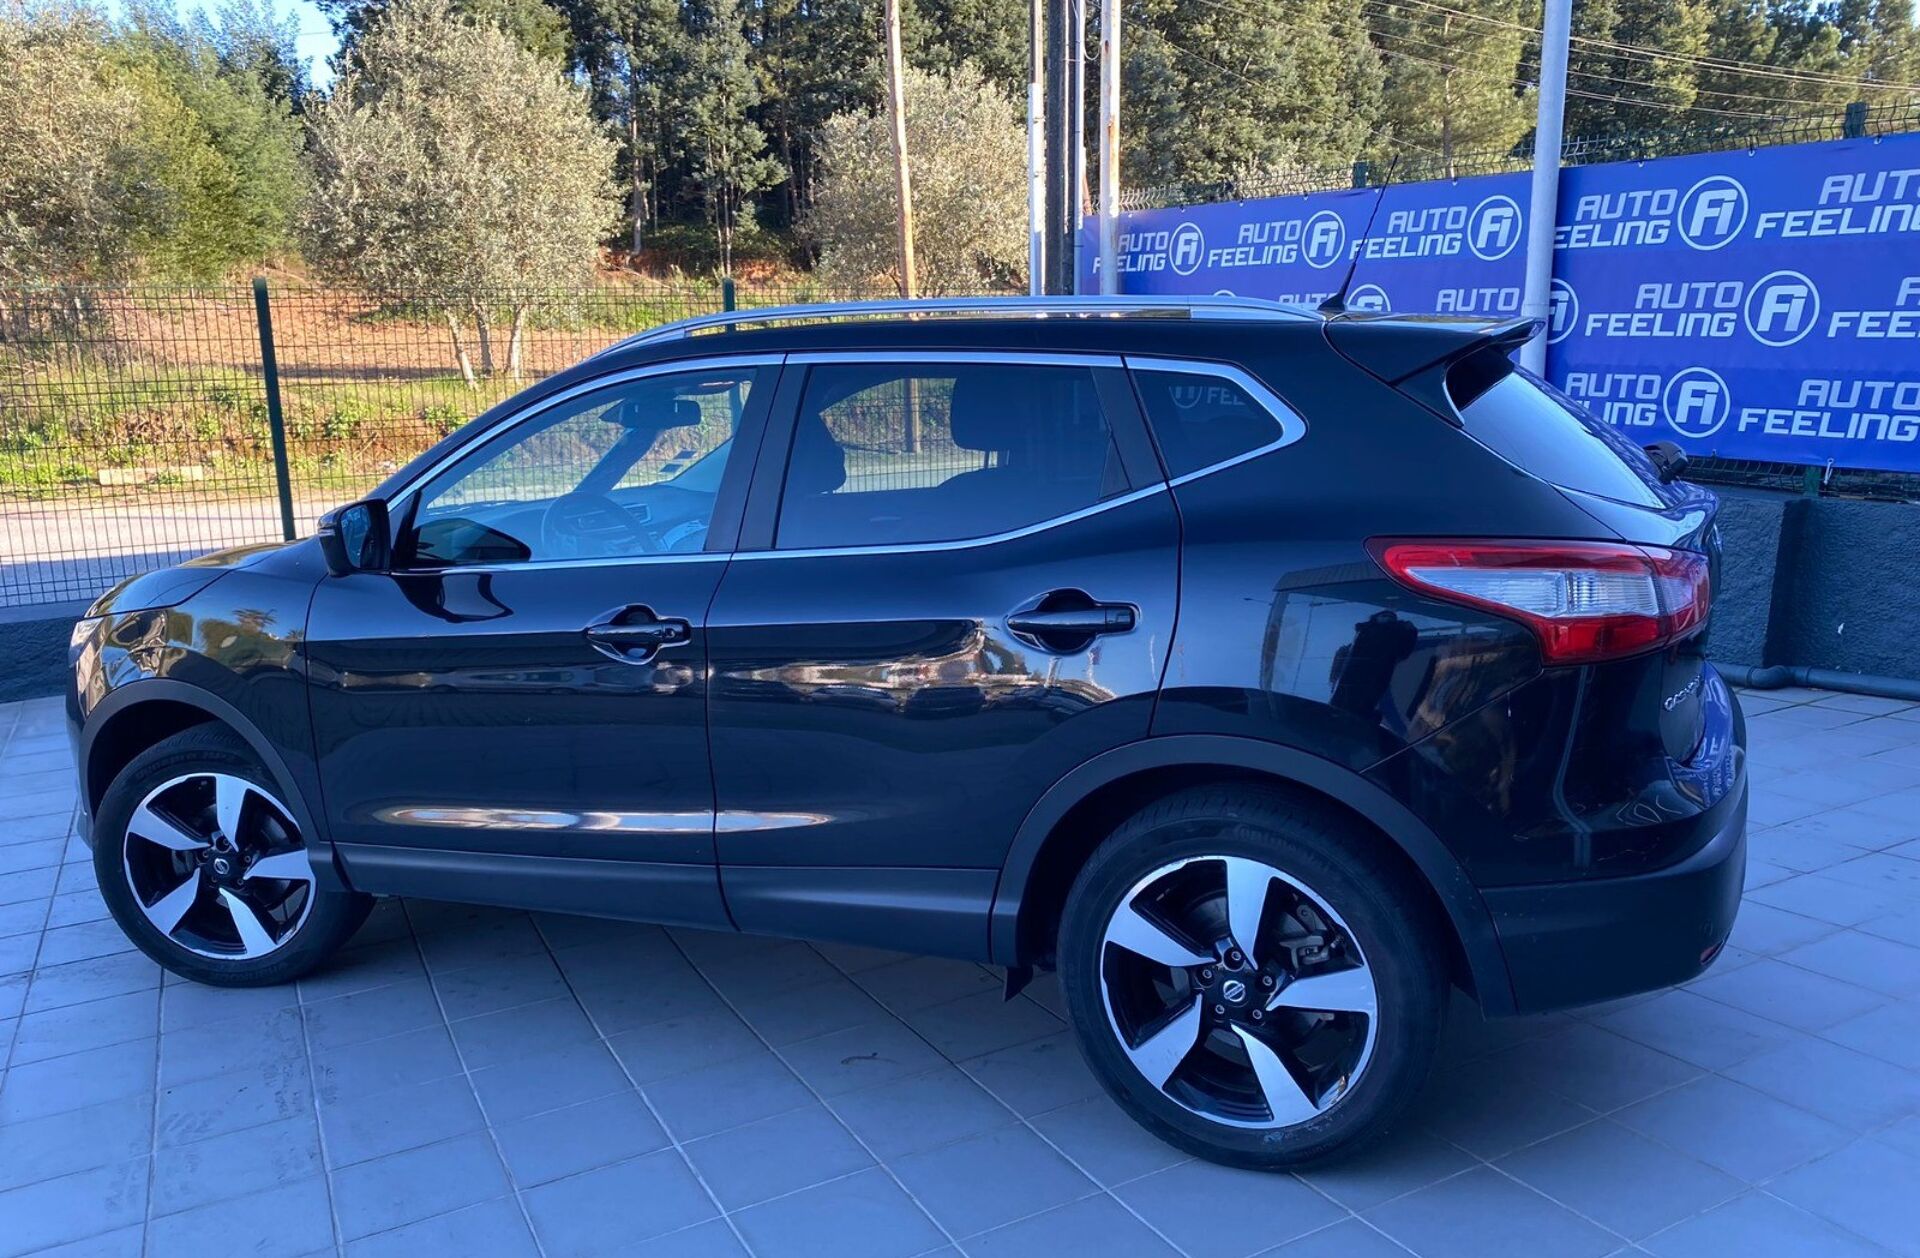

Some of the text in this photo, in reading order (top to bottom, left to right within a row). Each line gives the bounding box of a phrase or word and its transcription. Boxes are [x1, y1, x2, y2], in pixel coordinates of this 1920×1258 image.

[1818, 168, 1920, 205] AUT
[1576, 189, 1678, 221] AUTO
[1238, 219, 1302, 244] AUTO
[1387, 206, 1467, 234] AUTO
[1118, 231, 1169, 252] AUTO
[1349, 233, 1462, 260] FEELING
[1554, 220, 1671, 249] EELING
[1092, 253, 1167, 274] FELING
[1207, 243, 1297, 268] FEELING
[1435, 287, 1520, 312] AUTO
[1635, 281, 1744, 309] AUTO
[1584, 312, 1738, 337] FEELING
[1827, 311, 1920, 338] FEE
[1565, 372, 1661, 399] AUTO
[1797, 379, 1920, 410] AUTO
[1737, 408, 1920, 442] FEELING
